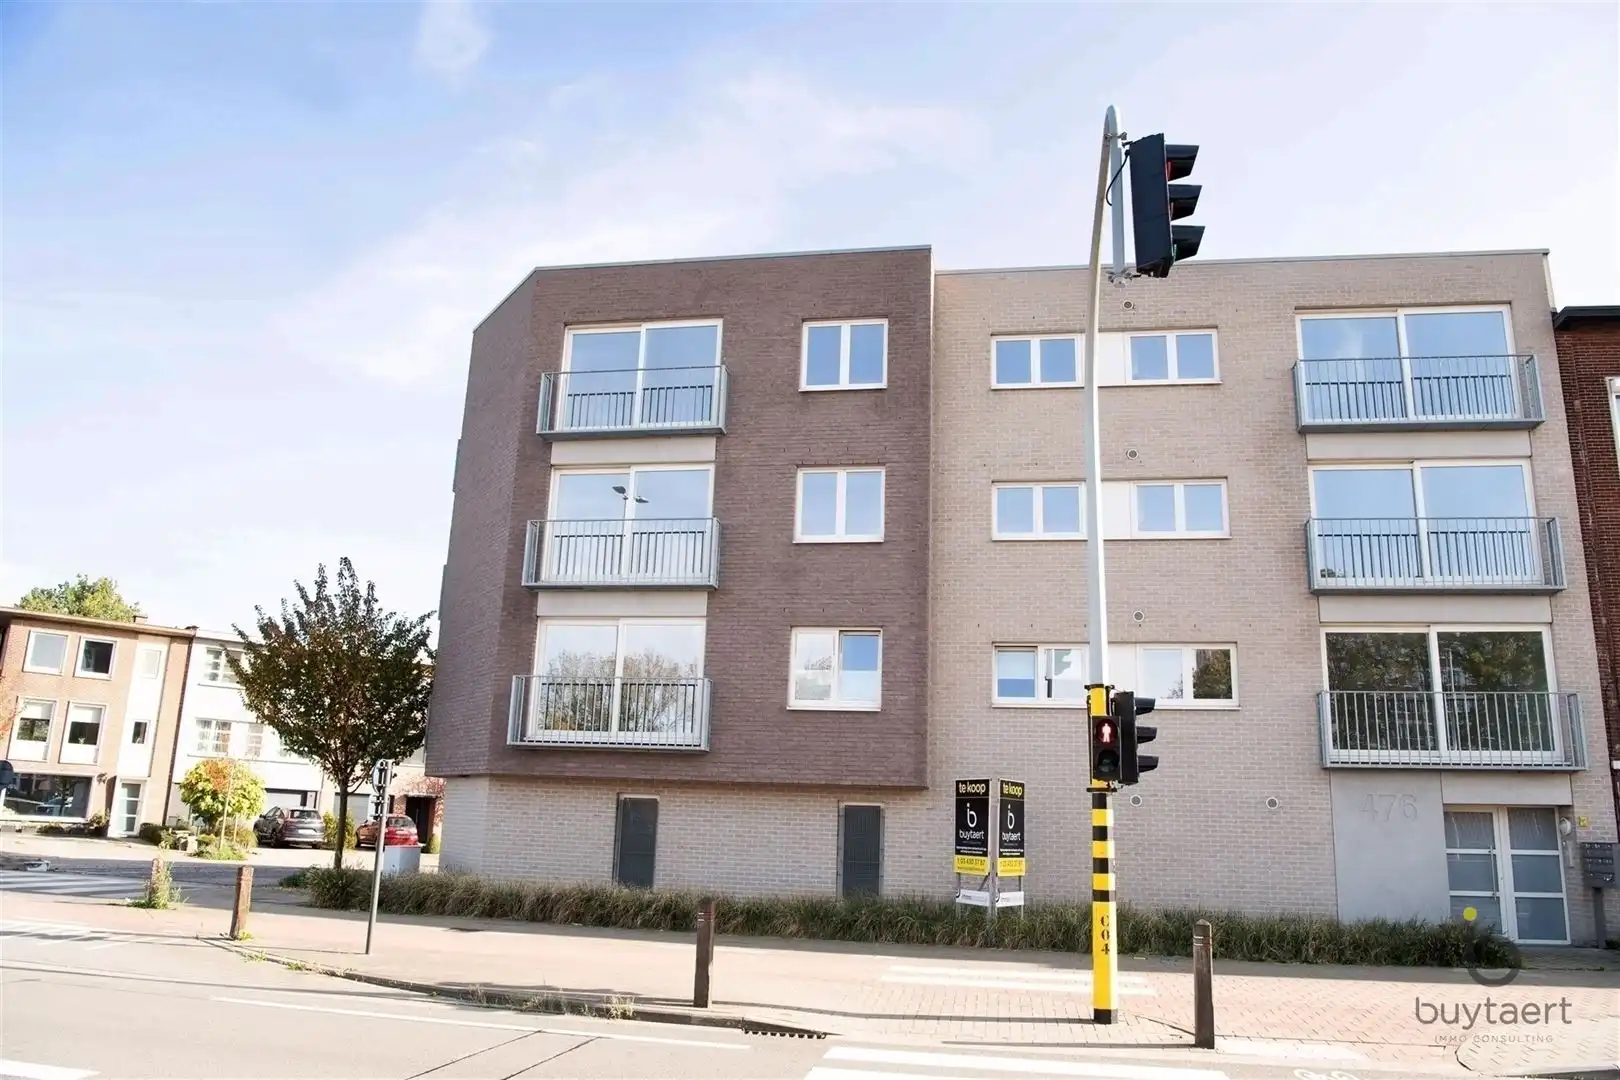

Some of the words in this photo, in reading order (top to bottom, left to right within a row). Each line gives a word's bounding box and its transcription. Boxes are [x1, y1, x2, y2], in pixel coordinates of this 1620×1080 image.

[959, 782, 966, 793] te
[967, 781, 986, 795] koop
[1003, 782, 1008, 794] te
[1009, 783, 1023, 797] koop
[1359, 793, 1418, 821] 476
[959, 829, 984, 840] buytaert
[1002, 832, 1021, 842] buytaert
